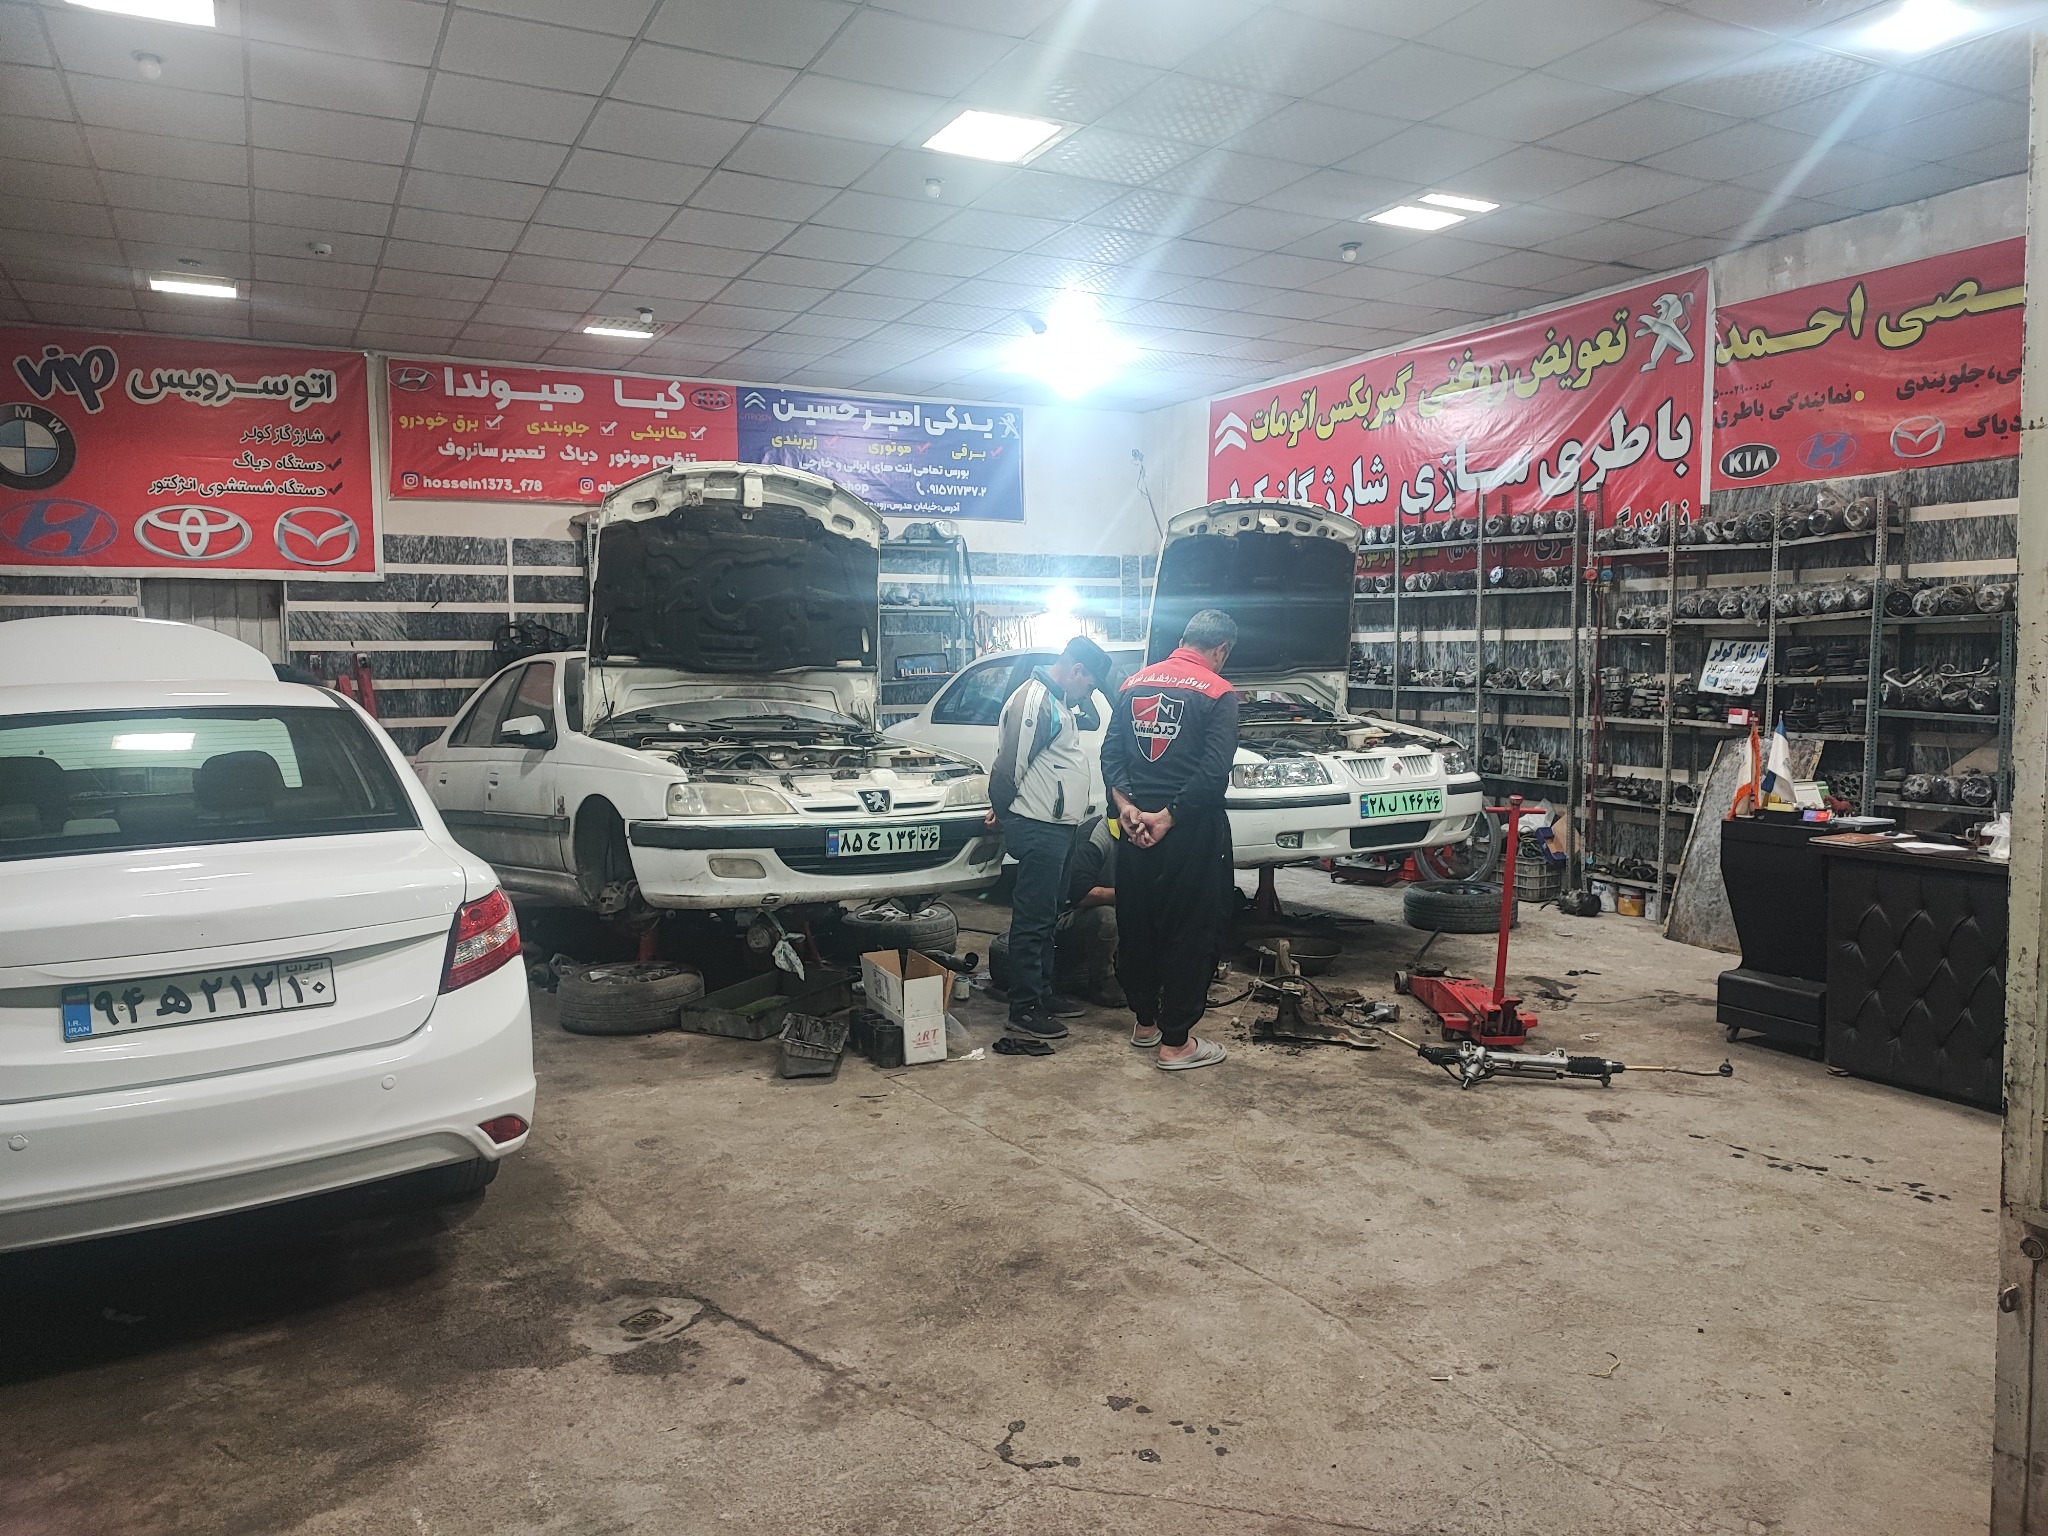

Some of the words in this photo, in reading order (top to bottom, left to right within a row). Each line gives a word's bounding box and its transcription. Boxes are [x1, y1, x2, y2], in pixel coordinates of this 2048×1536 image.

[1513, 308, 1629, 398] تعویض
[444, 367, 584, 410] هیوندا
[1895, 363, 1986, 400] جلوبندی
[614, 379, 685, 418] کیا
[1317, 362, 1413, 440] گیربکس
[1769, 383, 1853, 420] نمایندگی
[772, 395, 860, 426] حسین
[863, 405, 920, 432] امیر
[1250, 386, 1318, 448] اتومات
[1714, 398, 1765, 429] باطری
[398, 413, 448, 429] خودرو
[452, 417, 479, 433] برق
[526, 418, 589, 437] جلوبندی
[924, 406, 993, 439] یدکی
[239, 424, 272, 444] کولر
[271, 425, 292, 446] گاز
[292, 427, 325, 446] شارژ
[630, 424, 687, 442] مکانیکی
[771, 434, 817, 450] زیربندی
[437, 437, 498, 460] سانروف
[501, 445, 546, 463] تعمیر
[867, 441, 912, 455] موتوری
[951, 443, 986, 460] برقی
[1538, 398, 1694, 498] باطری
[232, 450, 272, 473] دیاگ
[275, 453, 326, 473] دستگاه
[608, 449, 650, 468] موتور
[836, 463, 843, 472] و
[844, 458, 870, 473] ایرانی
[871, 462, 894, 474] های
[895, 463, 913, 474] لنت
[1728, 449, 1769, 474] KIA
[913, 464, 944, 477] تمامی
[944, 468, 970, 480] بورس
[1400, 438, 1530, 516] سازی
[148, 475, 197, 496] انژکتور
[199, 479, 276, 497] شستشوی
[277, 478, 327, 498] دستگاه
[1709, 641, 1737, 662] کولر
[68, 1025, 90, 1034] IRAN
